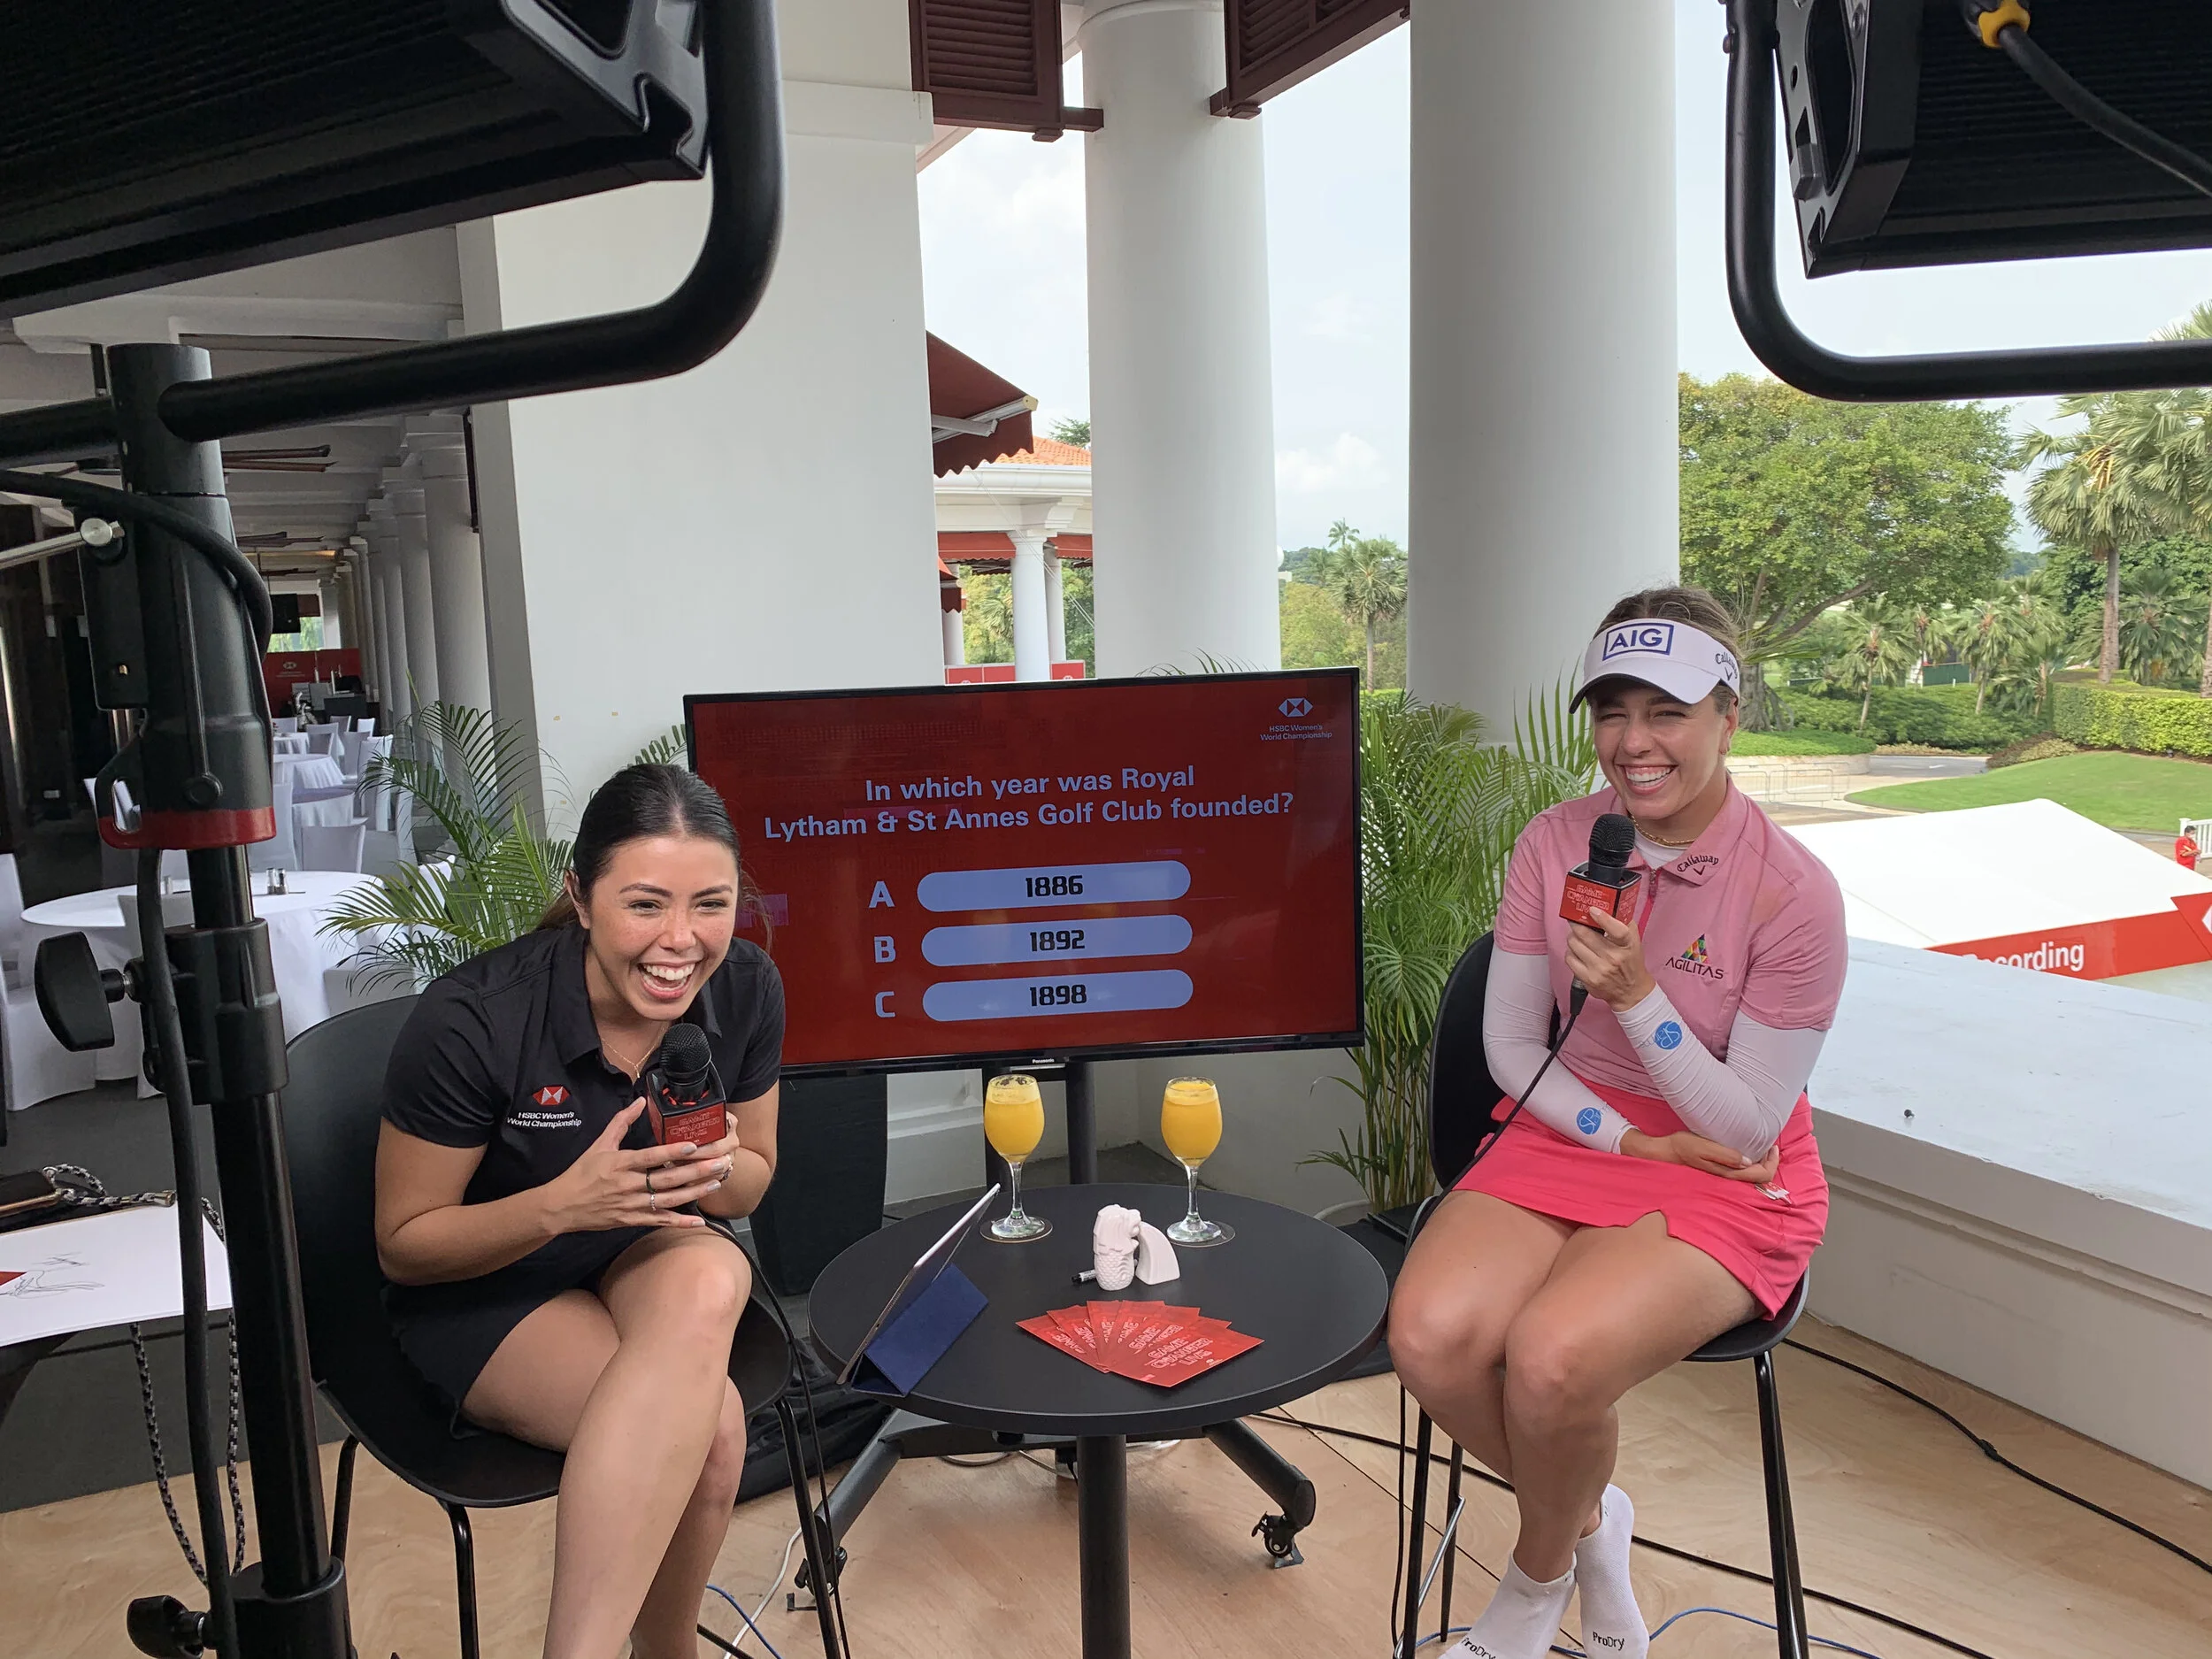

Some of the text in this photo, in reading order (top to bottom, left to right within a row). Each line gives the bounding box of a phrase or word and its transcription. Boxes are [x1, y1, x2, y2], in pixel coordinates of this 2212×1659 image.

[1609, 628, 1663, 652] AIG
[1282, 732, 1333, 741] Championship
[1291, 723, 1323, 732] Women's
[865, 764, 1194, 802] In which year was Royal
[764, 792, 1294, 842] Lytham & St Annes Golf Club founded?
[1677, 855, 1719, 872] Callaway
[868, 875, 1084, 909] A 1886
[1576, 885, 1603, 899] GAME
[1575, 902, 1591, 913] LIV
[873, 929, 1086, 964] B 1892
[1665, 956, 1724, 979] AGILITAS
[874, 984, 1087, 1018] C 1898
[507, 1117, 582, 1129] World Championship
[541, 1111, 575, 1120] Women's
[1148, 1338, 1189, 1359] GAME
[1593, 1632, 1625, 1651] ProDry
